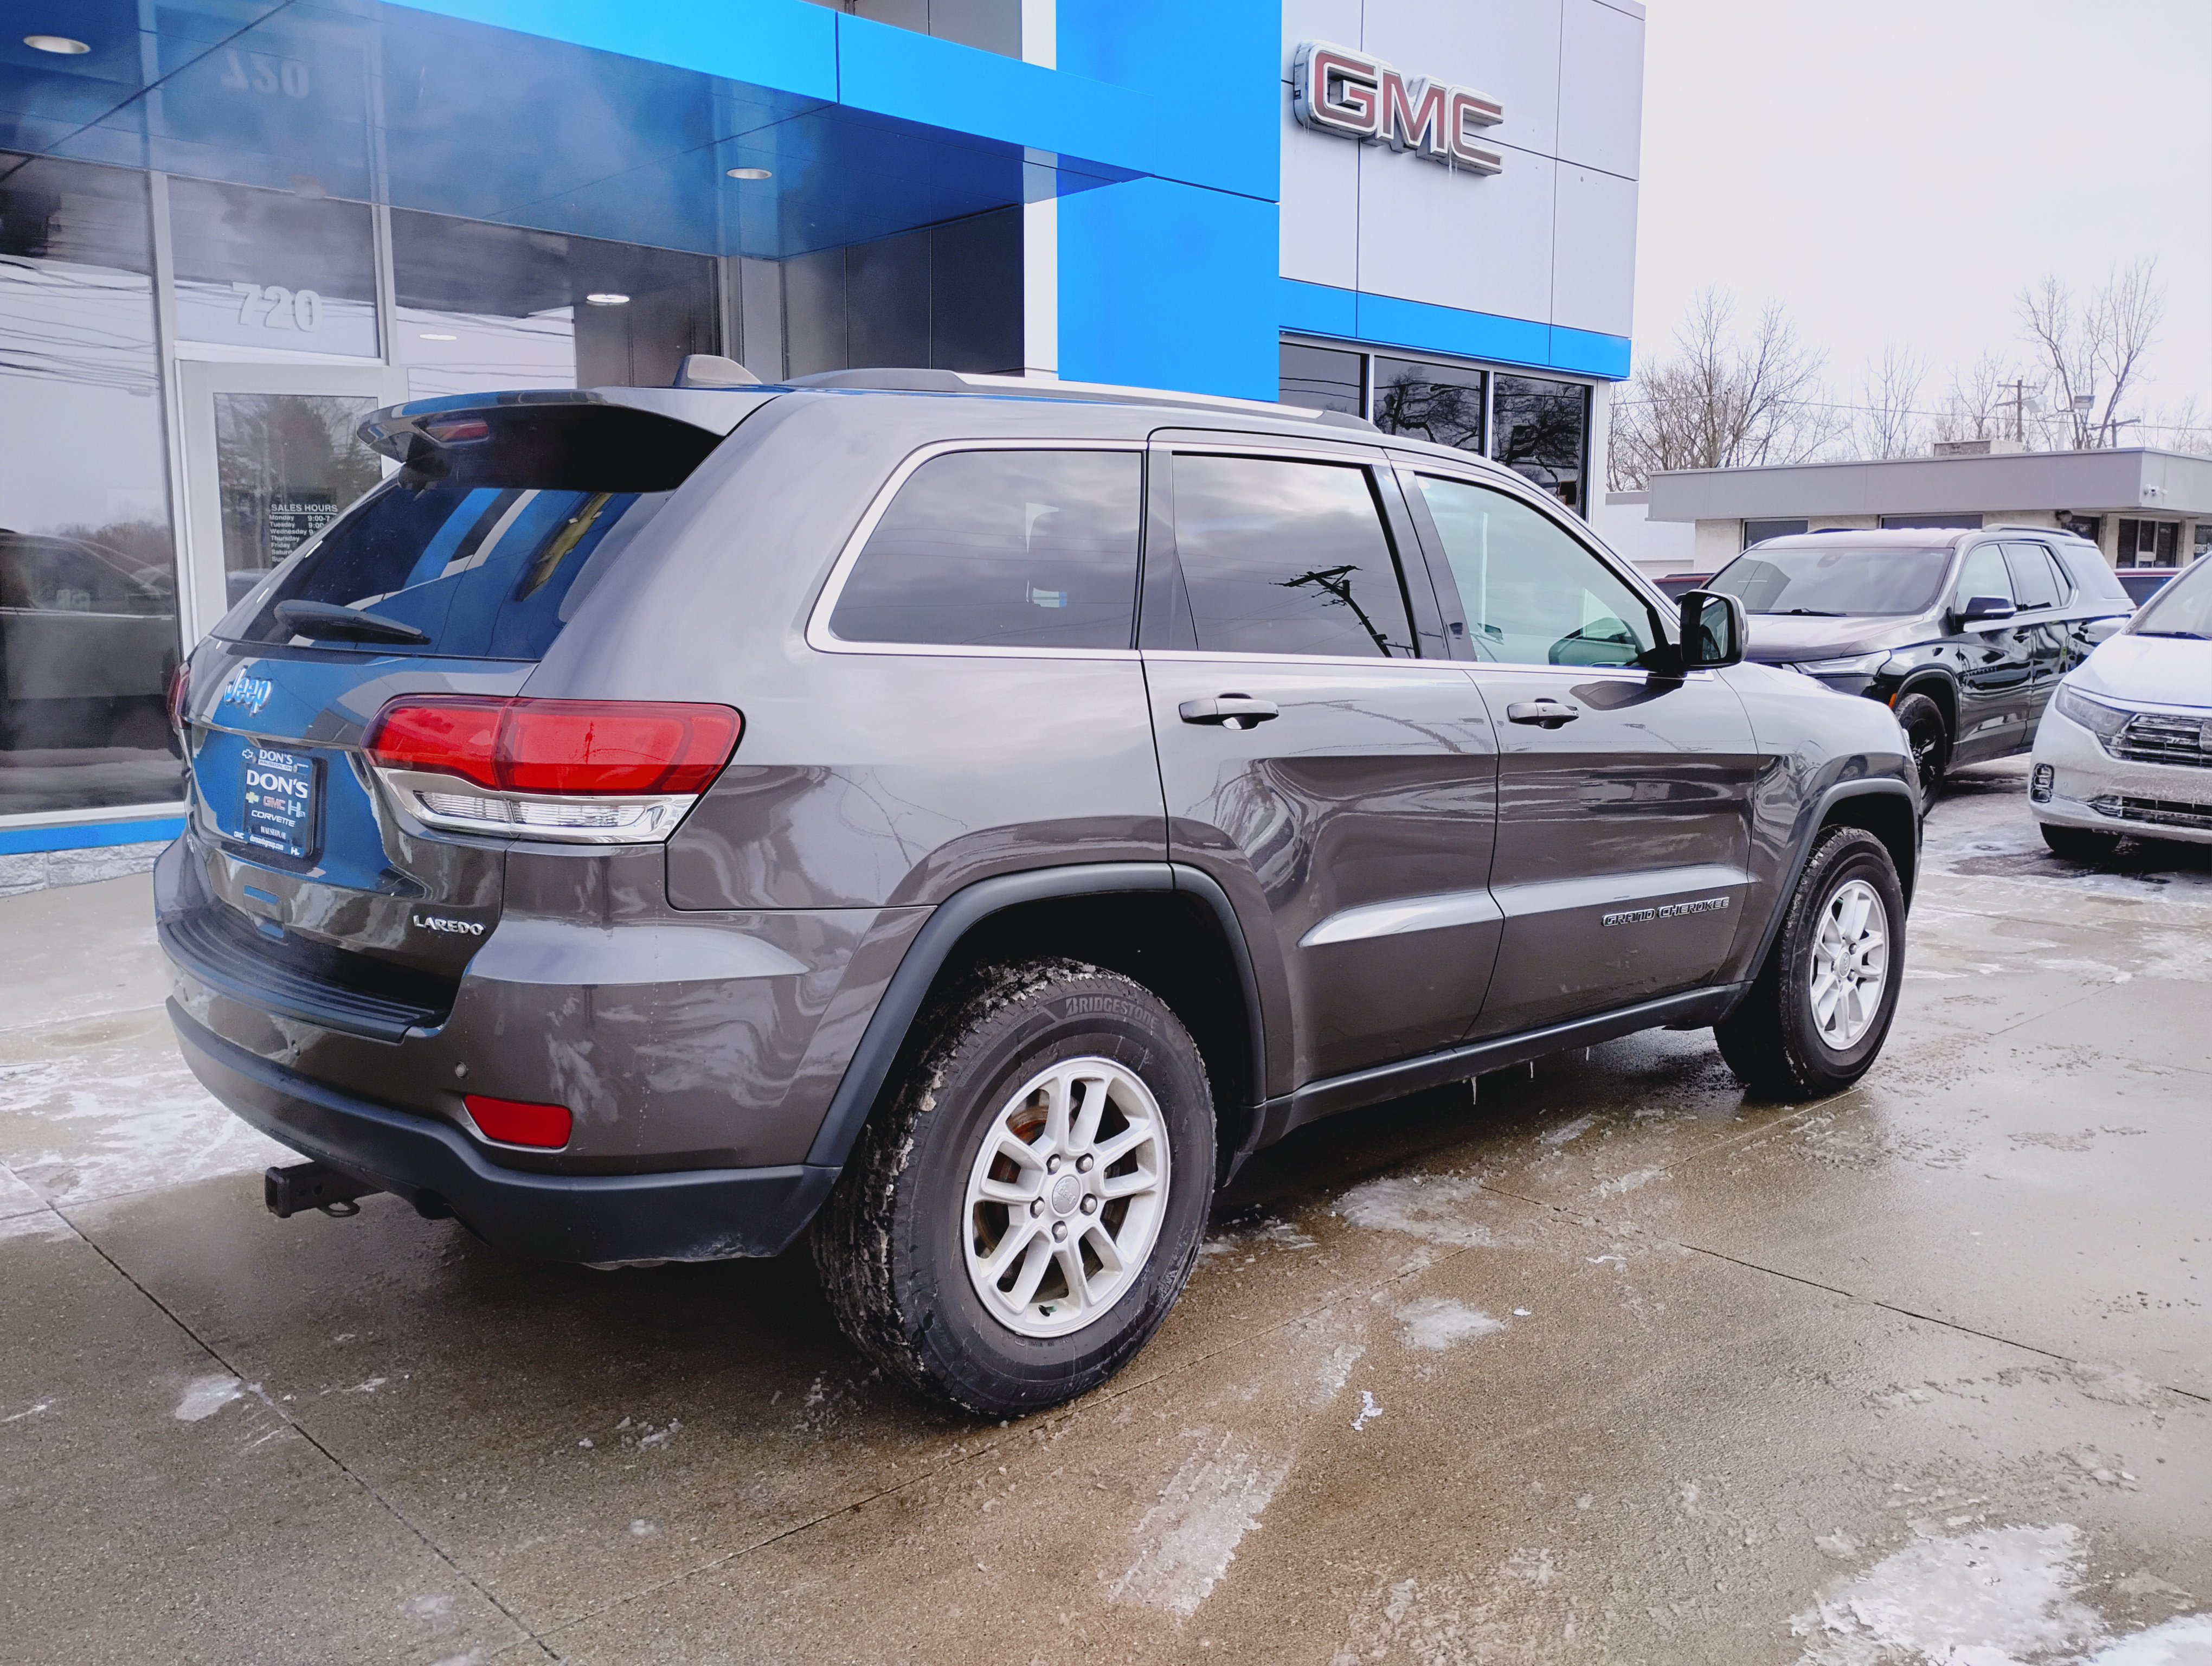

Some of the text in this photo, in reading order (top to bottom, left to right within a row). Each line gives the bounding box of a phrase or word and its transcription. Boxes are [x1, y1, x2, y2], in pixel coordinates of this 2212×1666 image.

[1301, 42, 1504, 174] GMC
[233, 281, 323, 332] 720
[224, 665, 273, 717] Jeep
[259, 749, 293, 765] DON'S
[246, 769, 308, 799] DON'S
[251, 810, 296, 827] CORVETTE
[263, 796, 286, 811] GMC
[413, 914, 486, 936] LAREDO
[1602, 896, 1730, 927] GRAND CHEROKEE
[1065, 997, 1160, 1027] BRIDGESTONE
